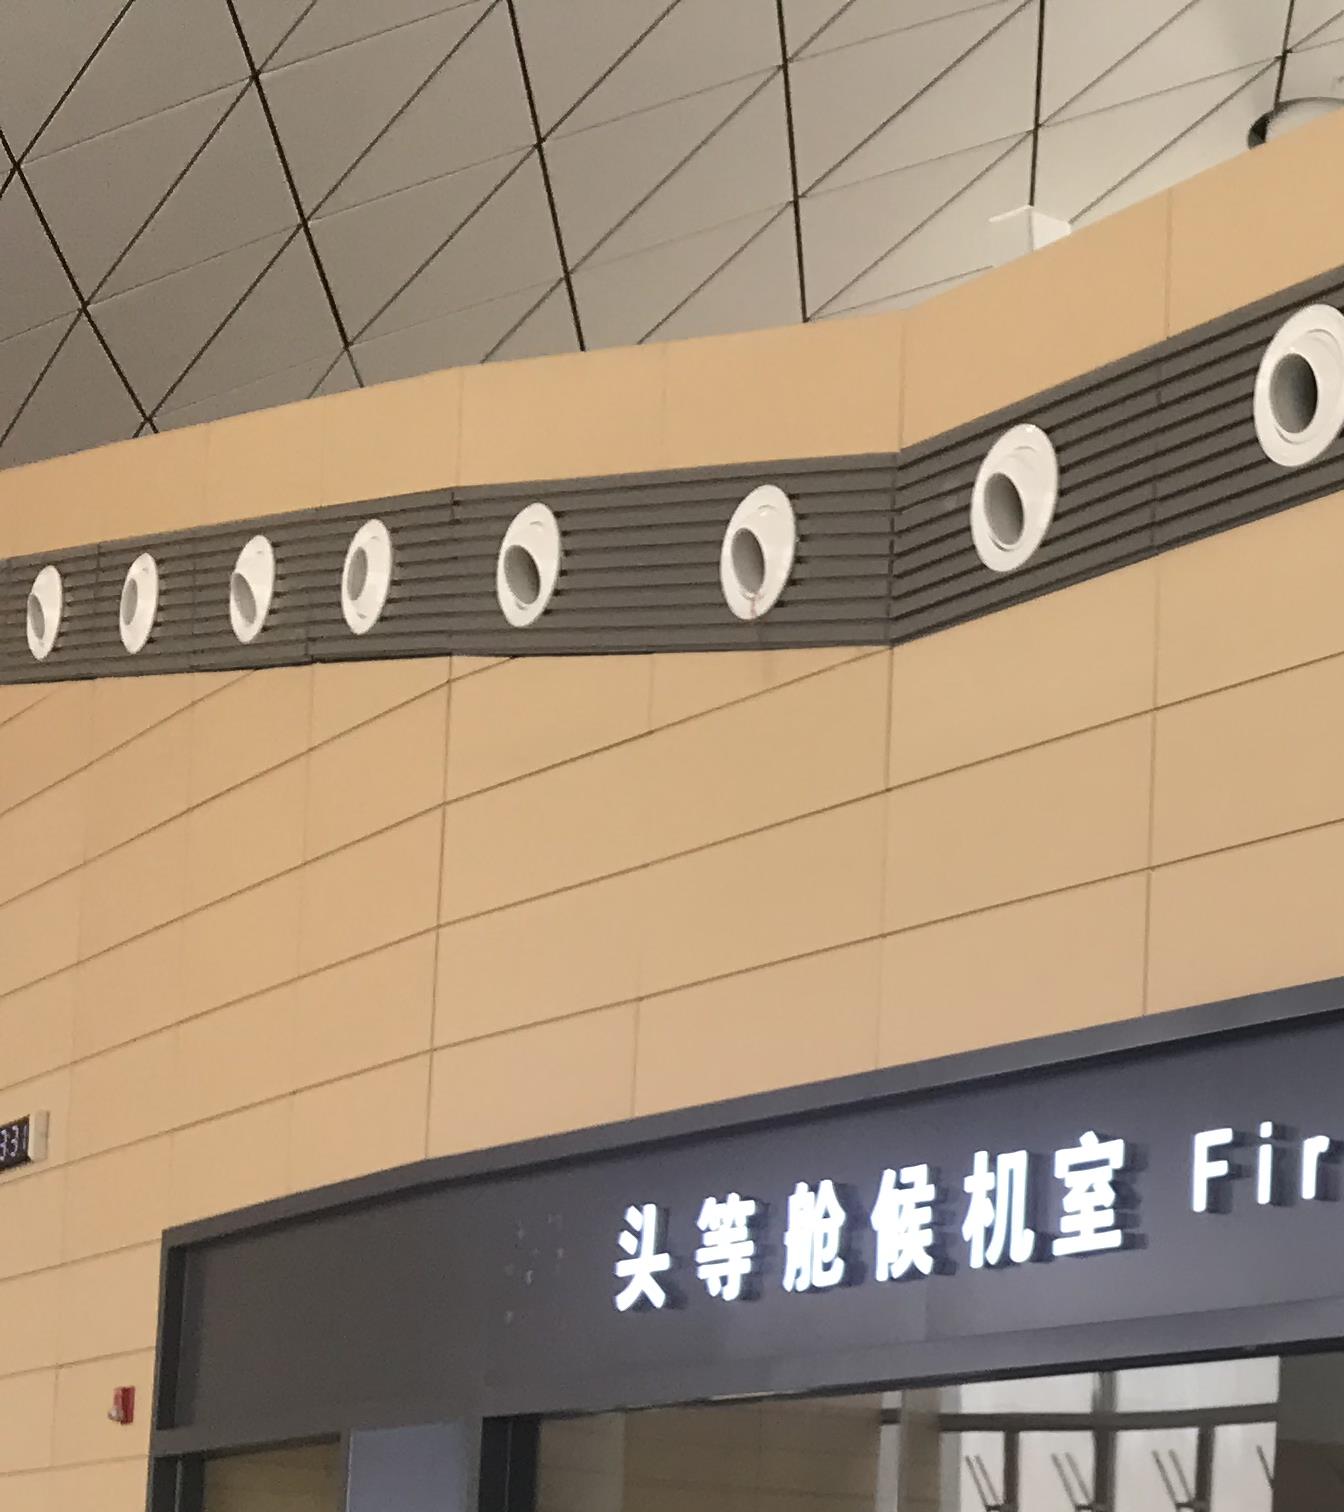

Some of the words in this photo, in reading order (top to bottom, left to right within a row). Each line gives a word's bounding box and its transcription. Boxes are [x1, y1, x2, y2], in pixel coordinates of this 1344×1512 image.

[614, 1131, 1125, 1312] 头等舱候机室
